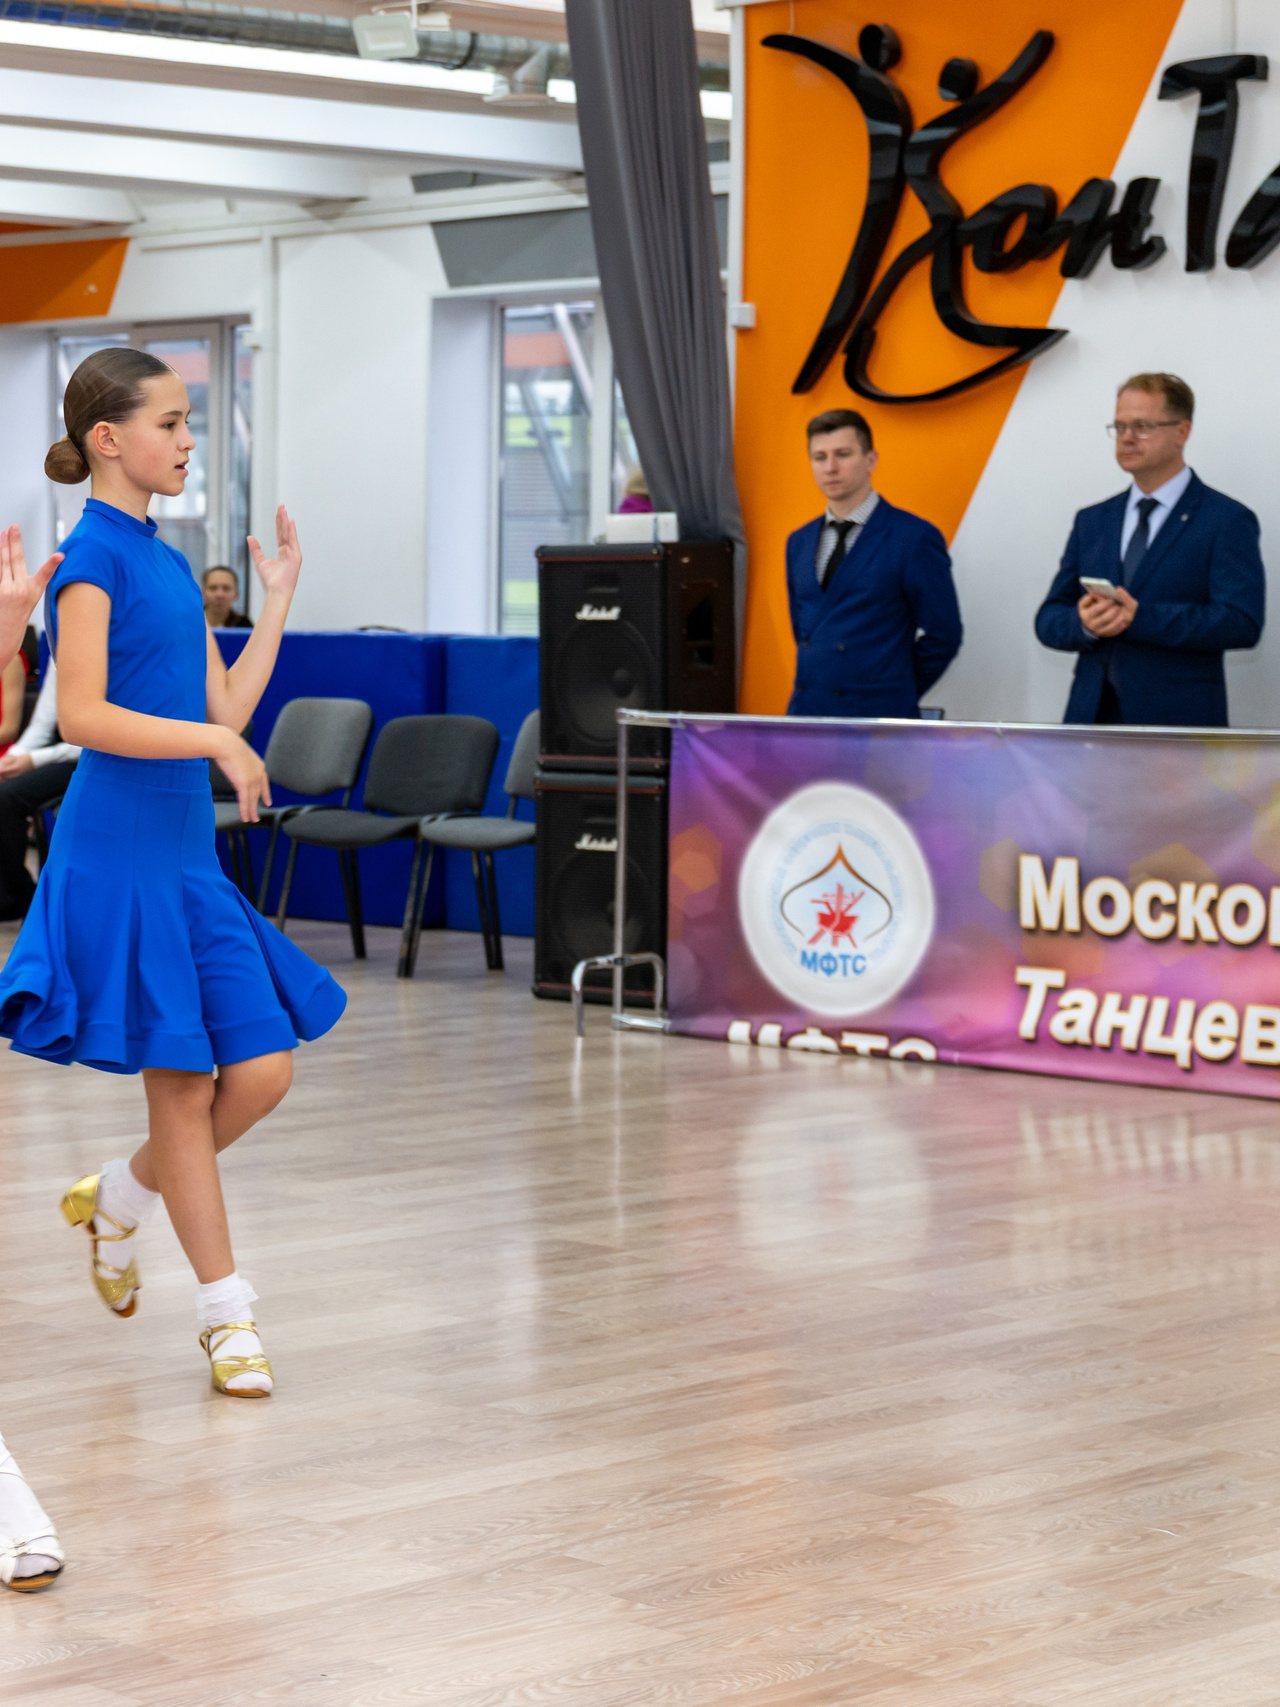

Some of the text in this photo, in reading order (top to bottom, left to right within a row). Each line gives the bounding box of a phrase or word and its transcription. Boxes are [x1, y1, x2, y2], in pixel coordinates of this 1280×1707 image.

[1019, 854, 1280, 946] Моско
[800, 950, 868, 977] МФТС
[1015, 965, 1280, 1068] Танцев
